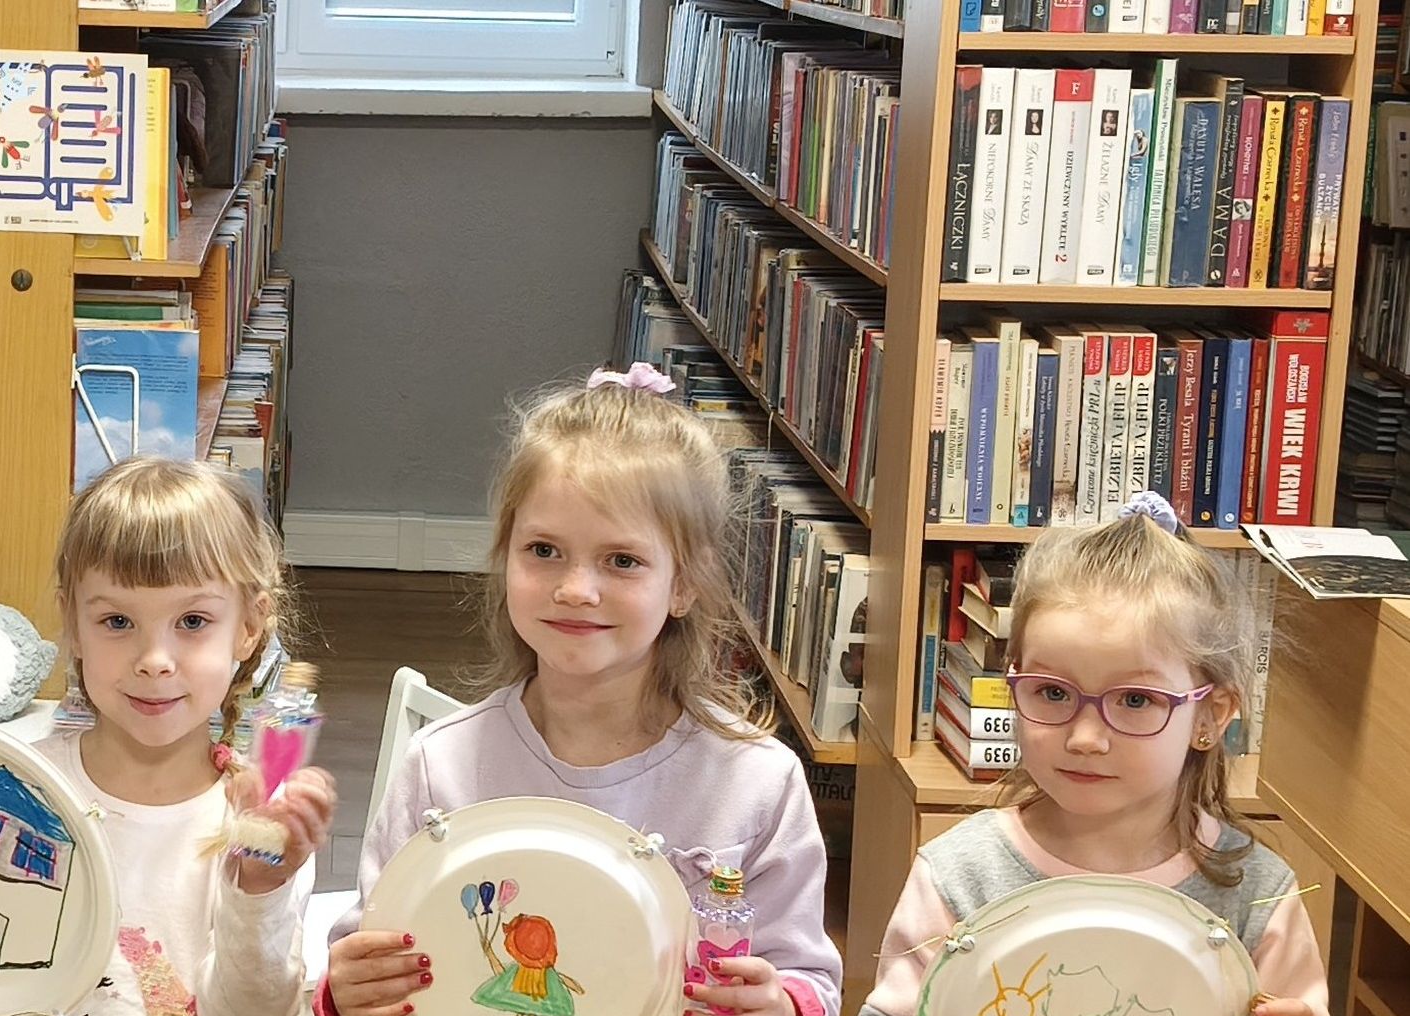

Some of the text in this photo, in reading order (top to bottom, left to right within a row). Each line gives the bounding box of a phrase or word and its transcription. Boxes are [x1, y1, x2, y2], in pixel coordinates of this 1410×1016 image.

[1195, 117, 1209, 161] DANUTA
[1295, 117, 1308, 147] Renata
[1331, 111, 1342, 132] John
[984, 143, 996, 203] NIEPOKORNE
[1064, 151, 1074, 208] DZIEWCZYNY
[1099, 142, 1114, 187] ŻELAZNE
[951, 163, 971, 250] ŁĄCZNICZKI
[1324, 185, 1334, 214] ŻYCIE
[1059, 210, 1069, 250] WYKLĘTE
[1211, 186, 1233, 257] DAMA
[1055, 254, 1067, 263] 2
[1183, 349, 1198, 375] Jerzy
[1113, 382, 1127, 421] FILIP
[1136, 382, 1150, 421] FILIP
[1183, 377, 1197, 407] Besala
[1085, 415, 1100, 464] księżniczki
[1180, 414, 1195, 449] Tyrani
[1107, 432, 1124, 503] ELŻBIETA
[1131, 432, 1147, 494] LŻBIETA
[1179, 459, 1193, 493] błaźni
[1276, 408, 1307, 516] WIEK KRWI
[1082, 464, 1096, 515] Czerwone
[983, 717, 1010, 733] 939
